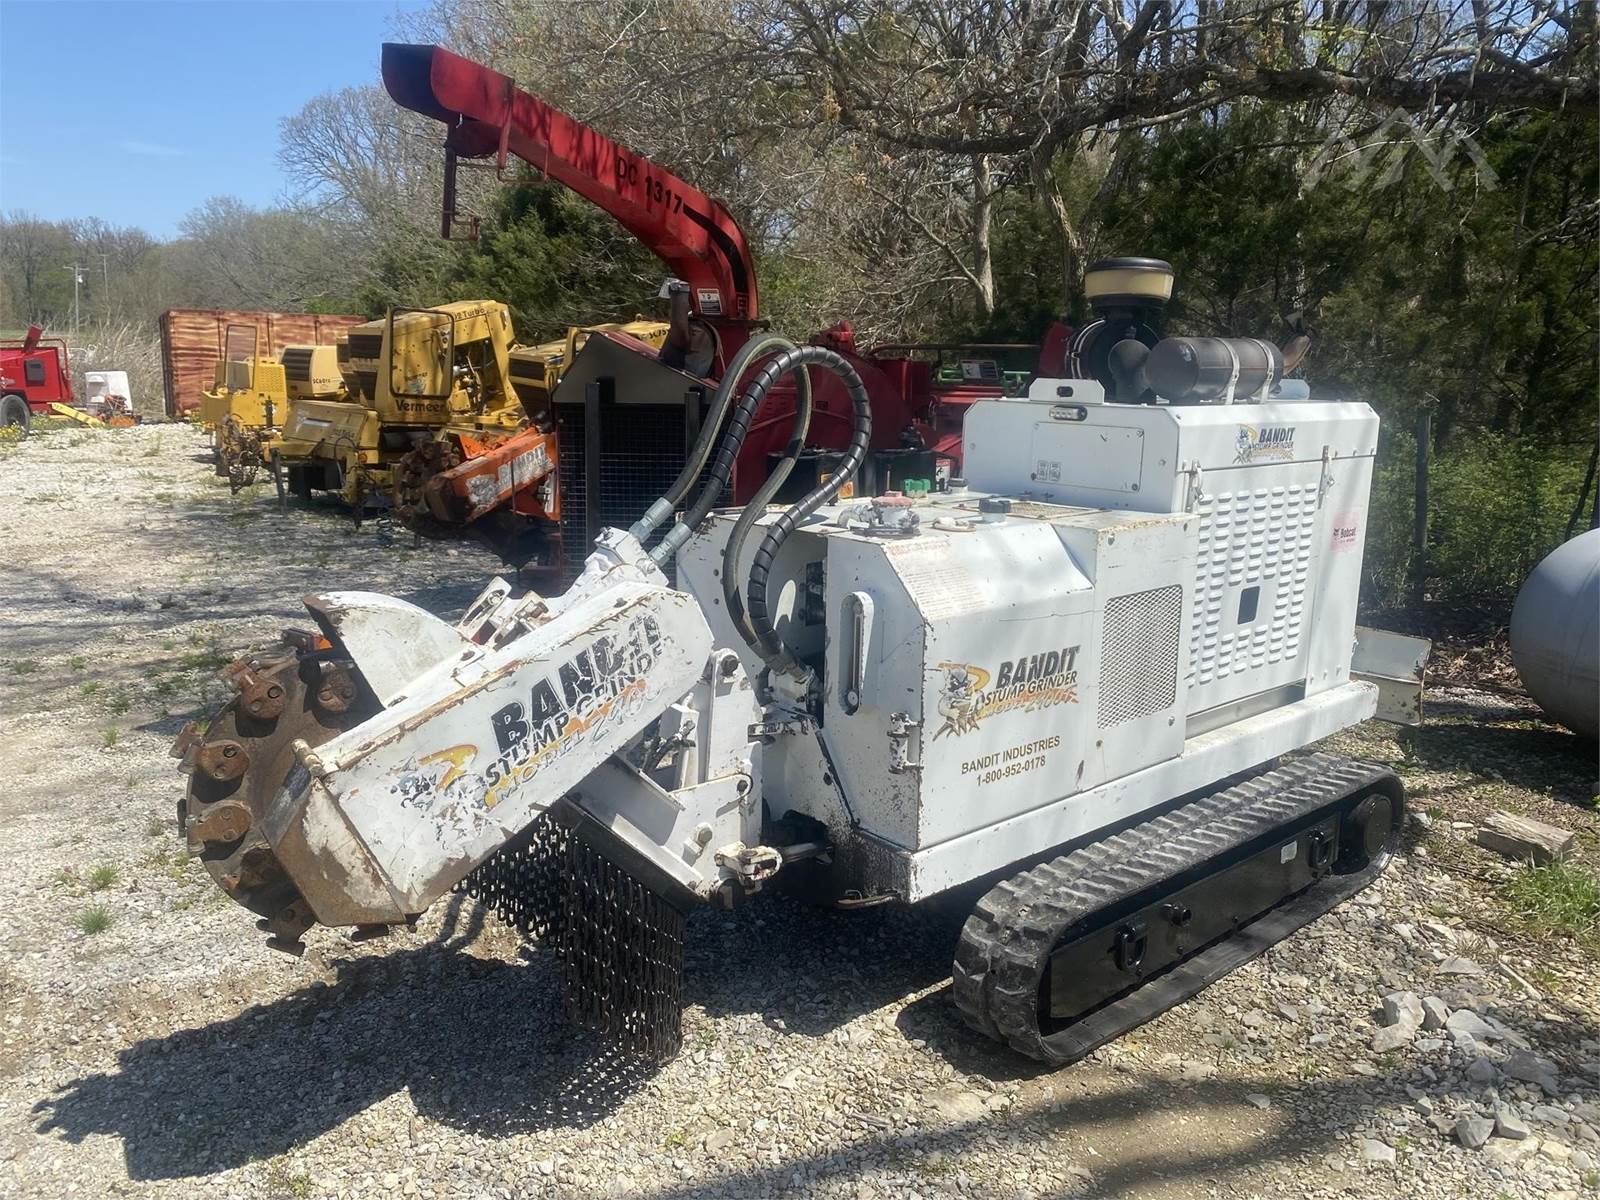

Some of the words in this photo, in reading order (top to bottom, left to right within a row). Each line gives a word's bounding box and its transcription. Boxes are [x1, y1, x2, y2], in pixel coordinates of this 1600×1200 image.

[617, 155, 638, 186] DC
[645, 175, 682, 214] 1317
[395, 399, 445, 412] Vermeer
[1258, 427, 1296, 443] BANDIT
[996, 645, 1081, 689] BANDIT
[985, 683, 1026, 706] STUMP
[1027, 670, 1078, 694] GRINDER
[485, 711, 570, 788] STUMP
[576, 637, 672, 718] GRINDE
[961, 753, 1000, 775] BANDIT
[1003, 736, 1061, 763] INDUSTRIES
[976, 755, 1046, 787] 1-800-952-0178
